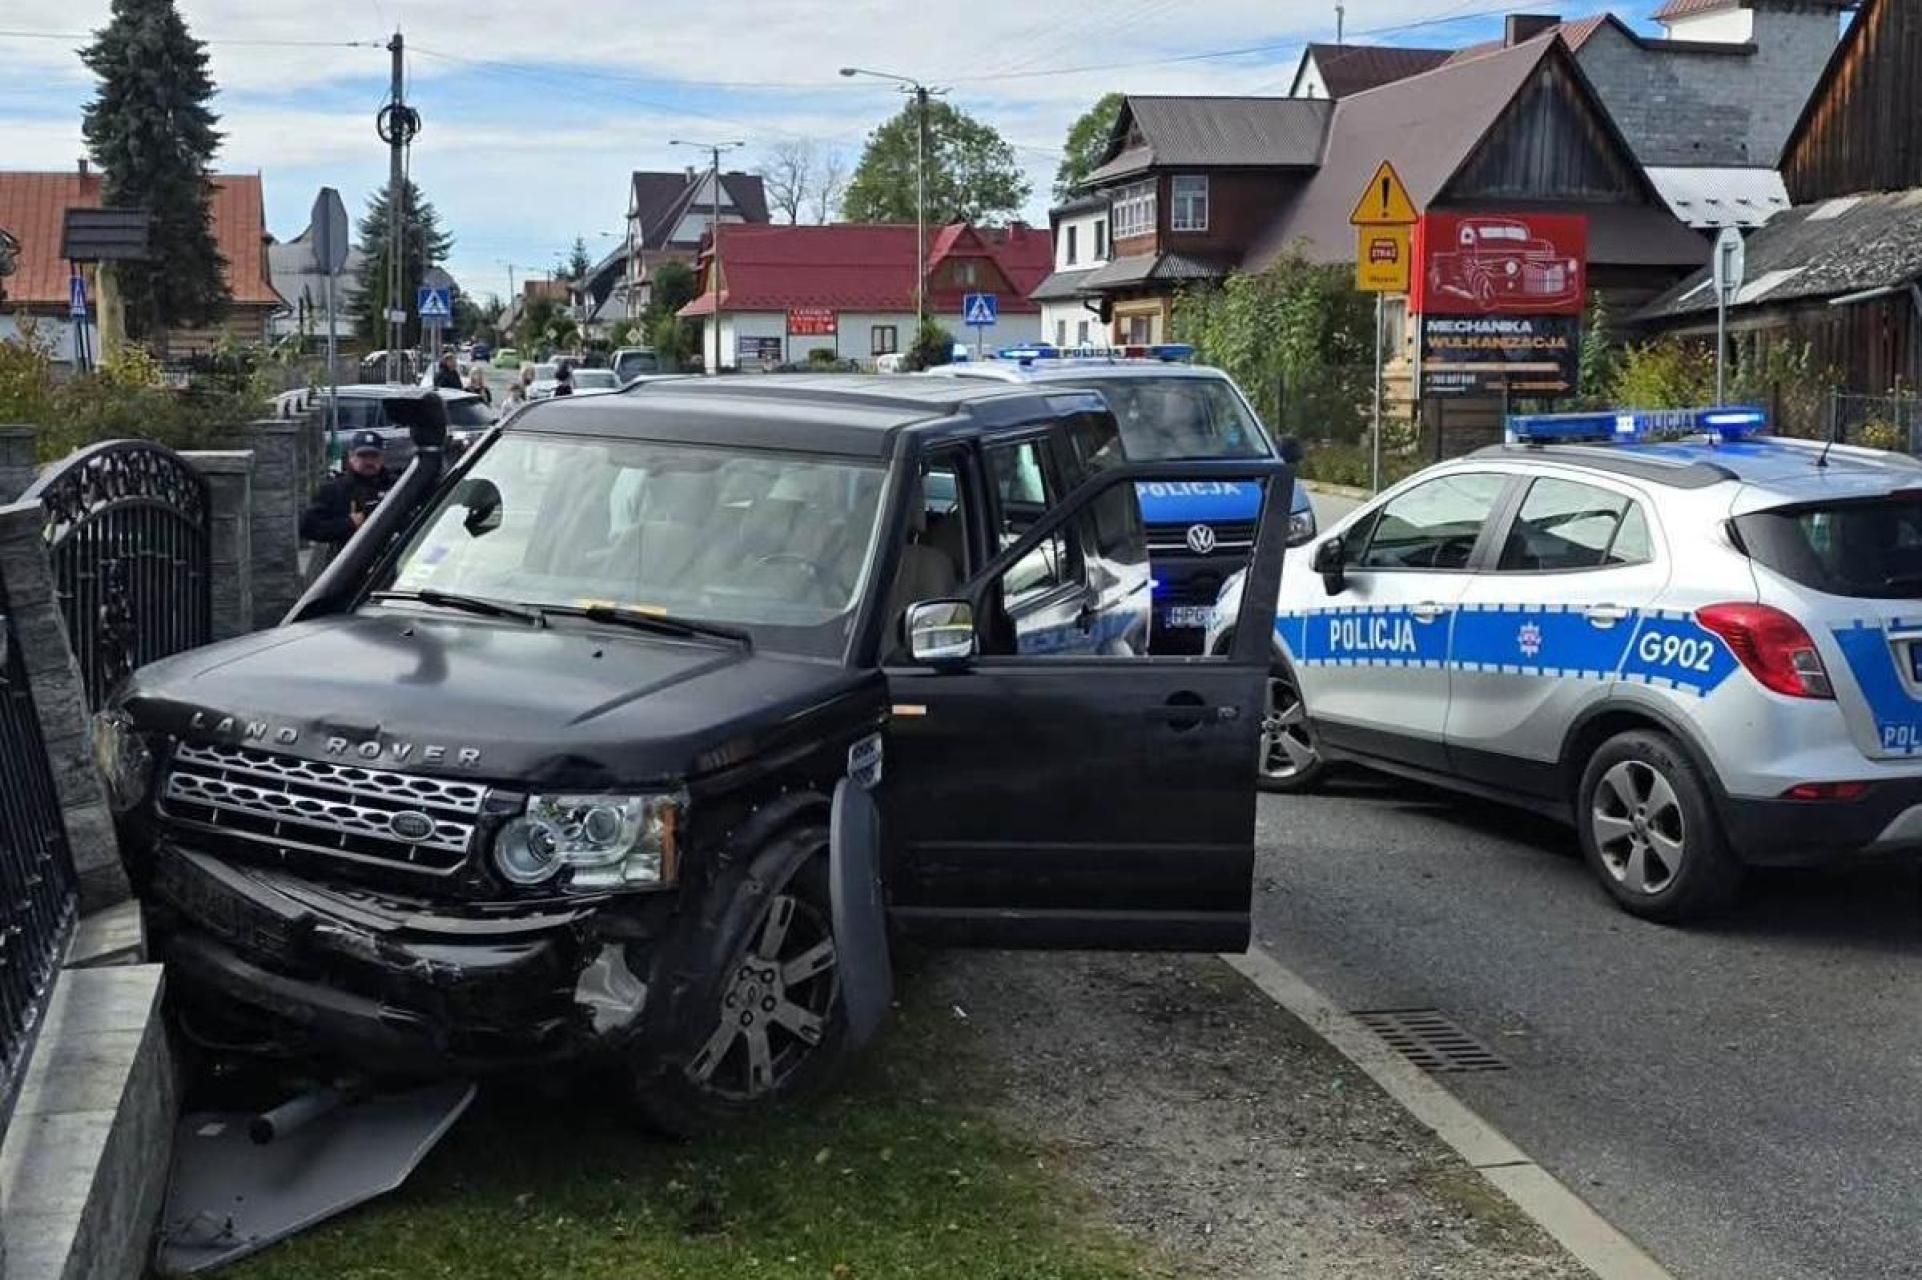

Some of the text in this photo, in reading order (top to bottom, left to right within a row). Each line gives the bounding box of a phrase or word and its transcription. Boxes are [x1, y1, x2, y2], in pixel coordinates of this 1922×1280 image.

[1135, 482, 1242, 498] POLICJA
[1330, 616, 1416, 652] POLICJA
[1640, 631, 1714, 672] G902
[190, 711, 481, 767] LAND ROVER
